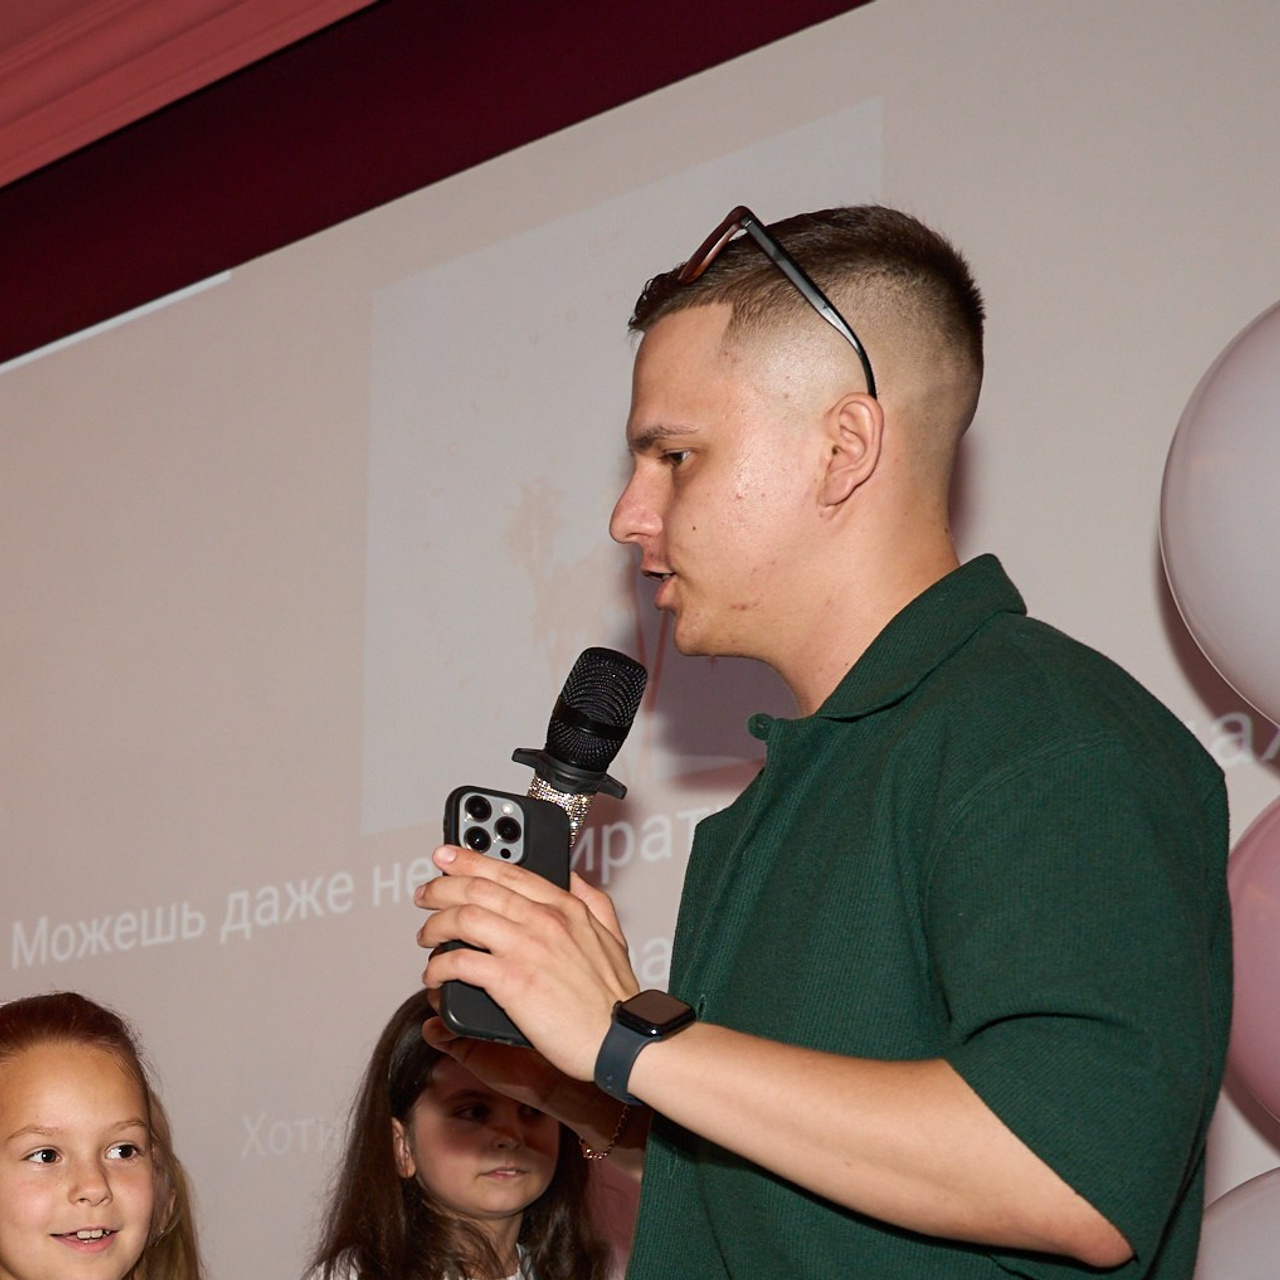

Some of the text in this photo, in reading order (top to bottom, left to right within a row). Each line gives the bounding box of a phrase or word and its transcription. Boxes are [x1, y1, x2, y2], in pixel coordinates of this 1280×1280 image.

[10, 900, 207, 970] Можешь
[219, 870, 354, 944] даже
[372, 855, 433, 907] не
[571, 805, 721, 885] ират
